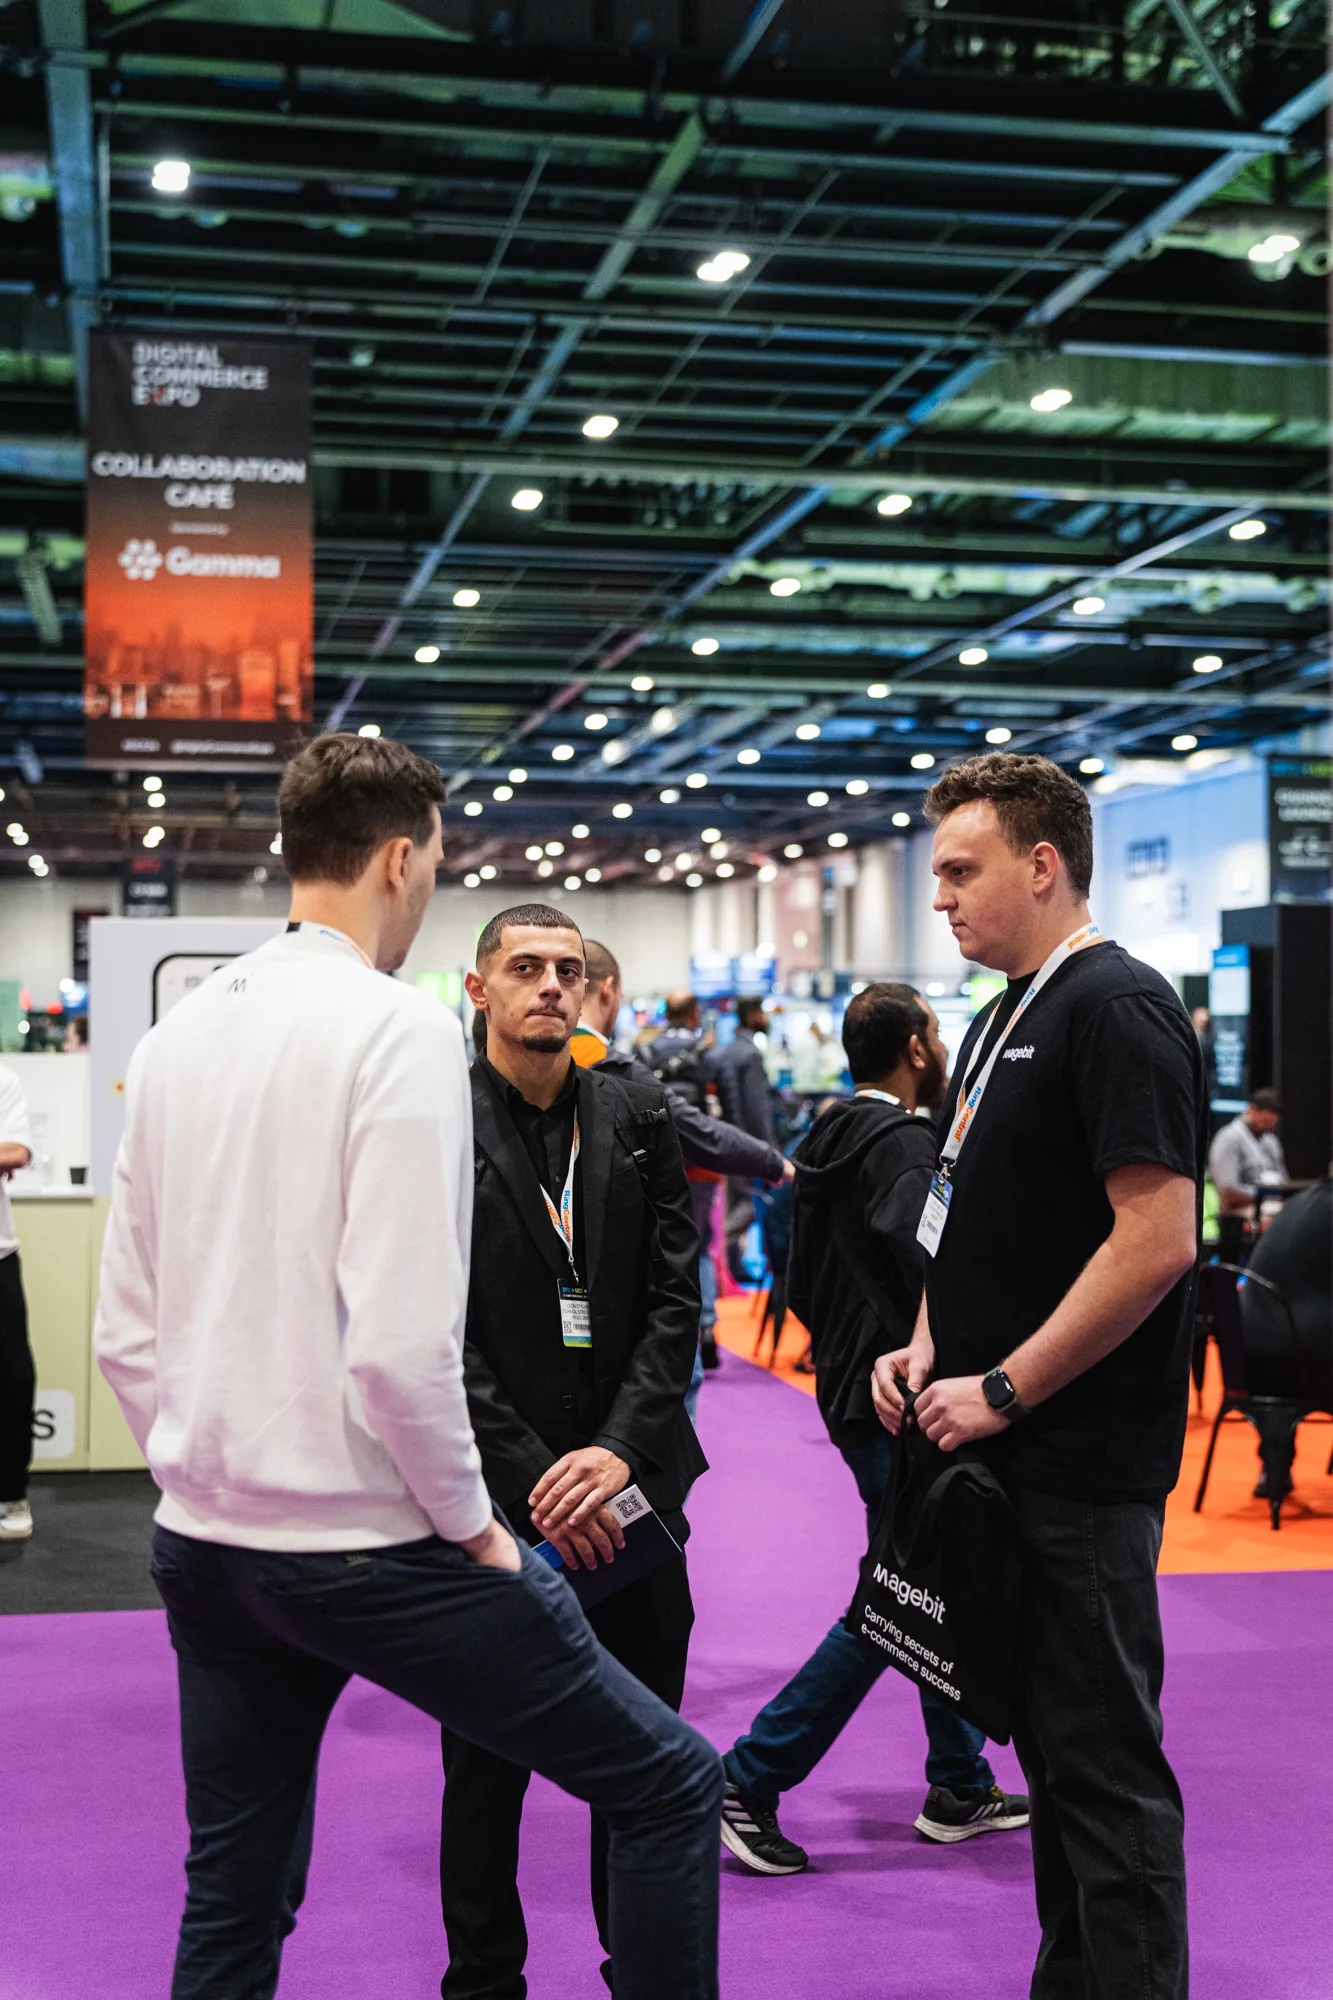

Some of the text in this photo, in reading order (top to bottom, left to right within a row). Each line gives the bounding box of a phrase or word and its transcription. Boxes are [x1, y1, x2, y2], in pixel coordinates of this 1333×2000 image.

[132, 340, 224, 367] DIGITAL
[132, 365, 269, 390] COMMERCE
[132, 386, 201, 407] EXPO
[92, 452, 307, 484] COLLABORATION
[165, 546, 281, 578] Gamma
[954, 1086, 982, 1142] RingCentral
[562, 1190, 572, 1242] RingCentral
[872, 1562, 946, 1624] Magebit
[864, 1604, 954, 1674] Carrying secrets of
[861, 1623, 961, 1701] e-commerce success
